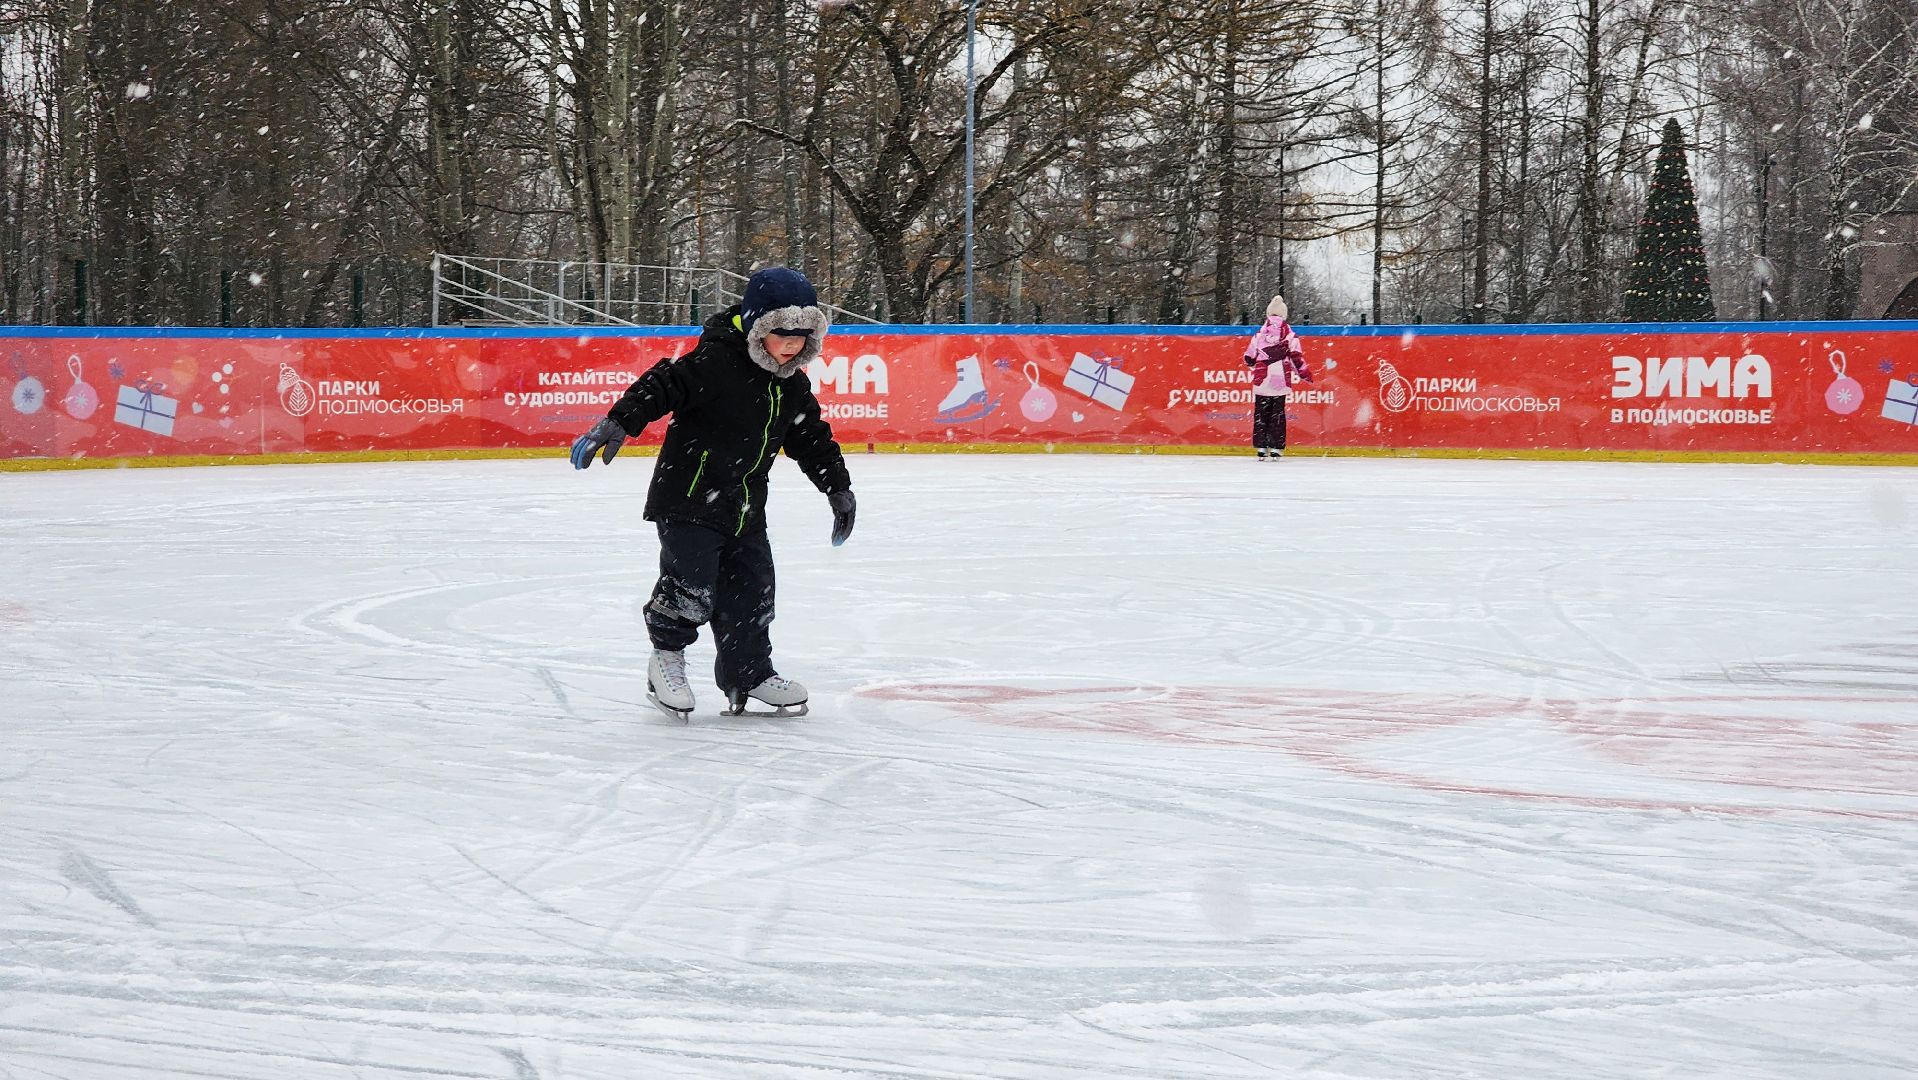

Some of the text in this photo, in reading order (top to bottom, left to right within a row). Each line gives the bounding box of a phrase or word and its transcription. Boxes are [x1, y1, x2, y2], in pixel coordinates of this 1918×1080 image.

[538, 369, 639, 385] КАТАЙТЕСЬ
[807, 354, 889, 394] МА
[1203, 370, 1301, 384] КАТАЬ
[1611, 355, 1773, 398] ЗИМА
[318, 381, 380, 396] ПАРКИ
[1415, 378, 1477, 393] ПАРКИ
[504, 391, 625, 407] С УДОВОЛЬСТ
[1169, 389, 1334, 405] С УДОВОЛВИЕМ!
[1415, 397, 1561, 412] ПОДМОСКОВЬЯ
[318, 399, 464, 414] ПОДМОСКОВЬЯ
[820, 404, 888, 419] СКОВЬЕ
[1611, 409, 1772, 426] В ПОДМОСКОВЬЕ
